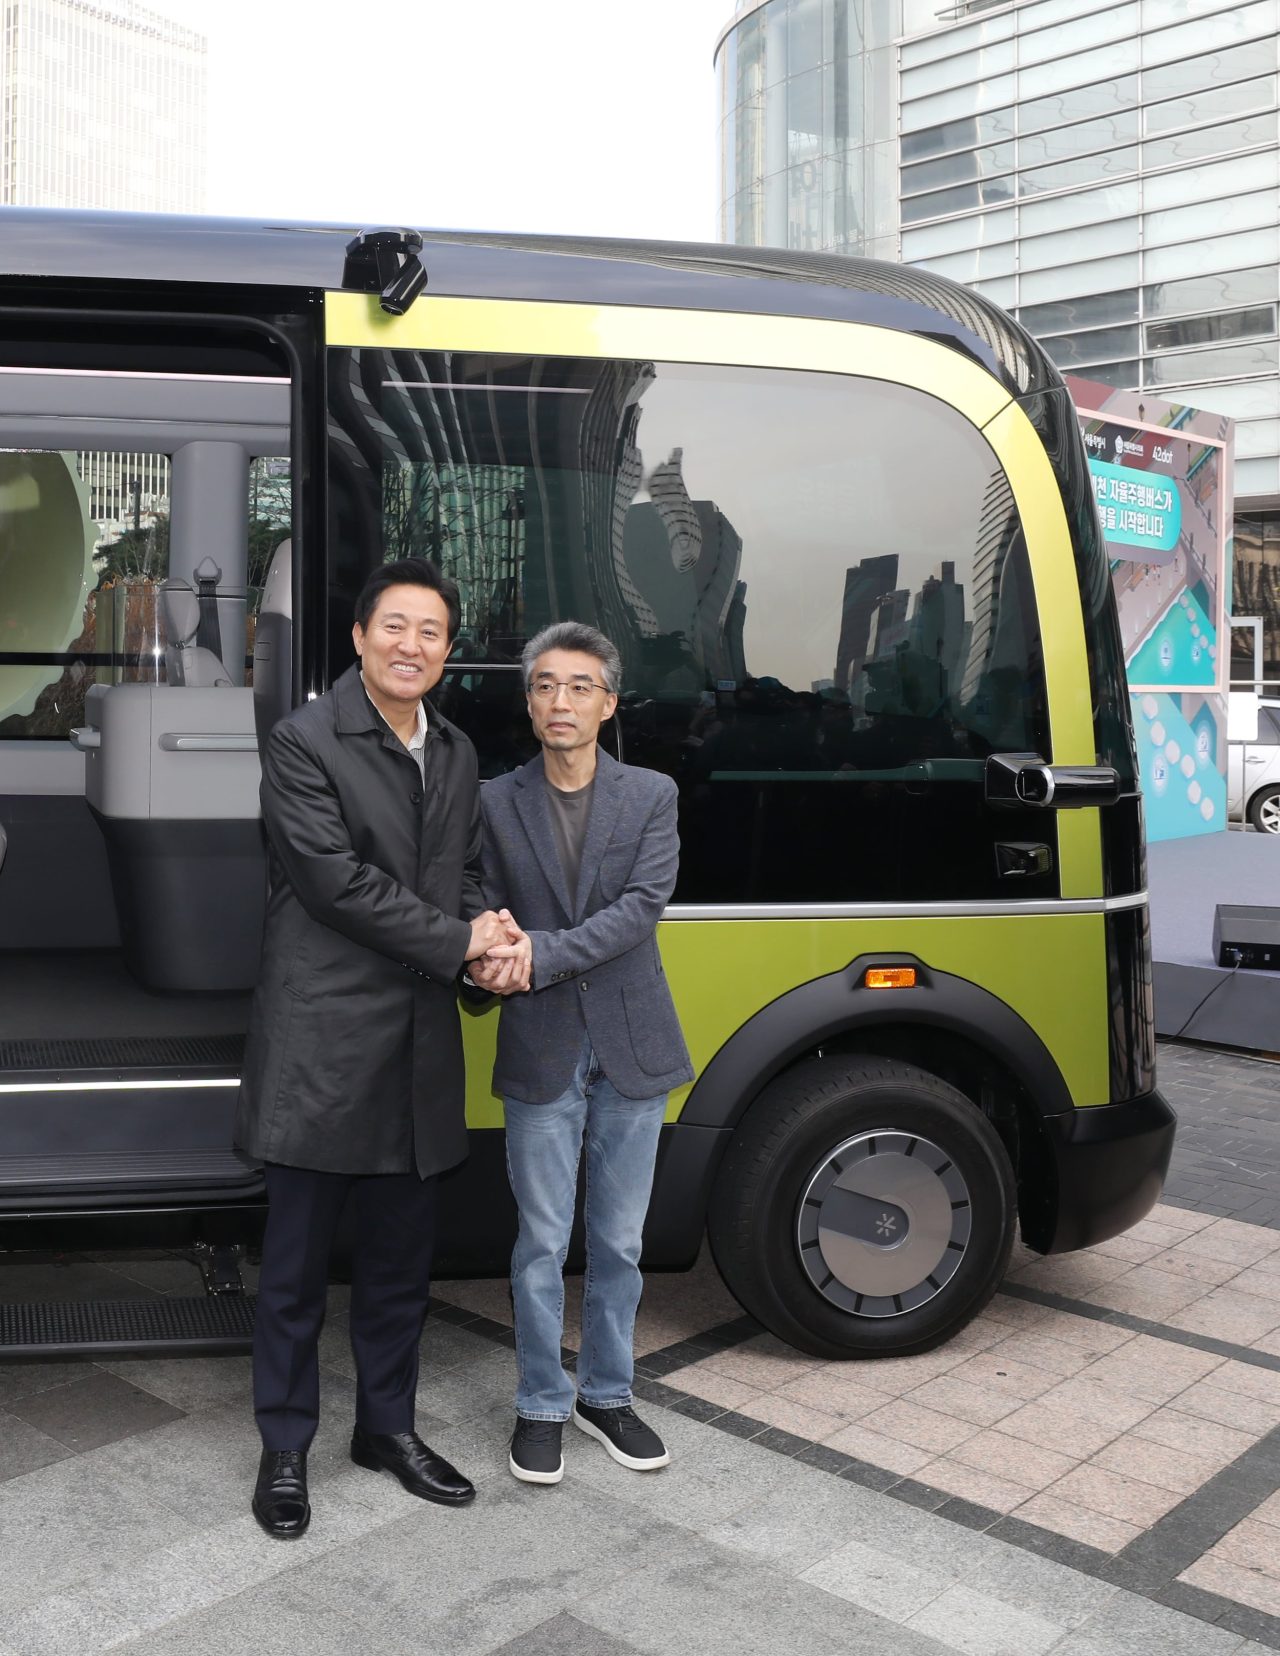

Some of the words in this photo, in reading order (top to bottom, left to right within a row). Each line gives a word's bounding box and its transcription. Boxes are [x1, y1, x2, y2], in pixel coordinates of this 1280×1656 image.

[1152, 446, 1174, 464] 42dot
[1109, 479, 1173, 512] 자율주행버스가
[1119, 511, 1164, 537] 시작합니다
